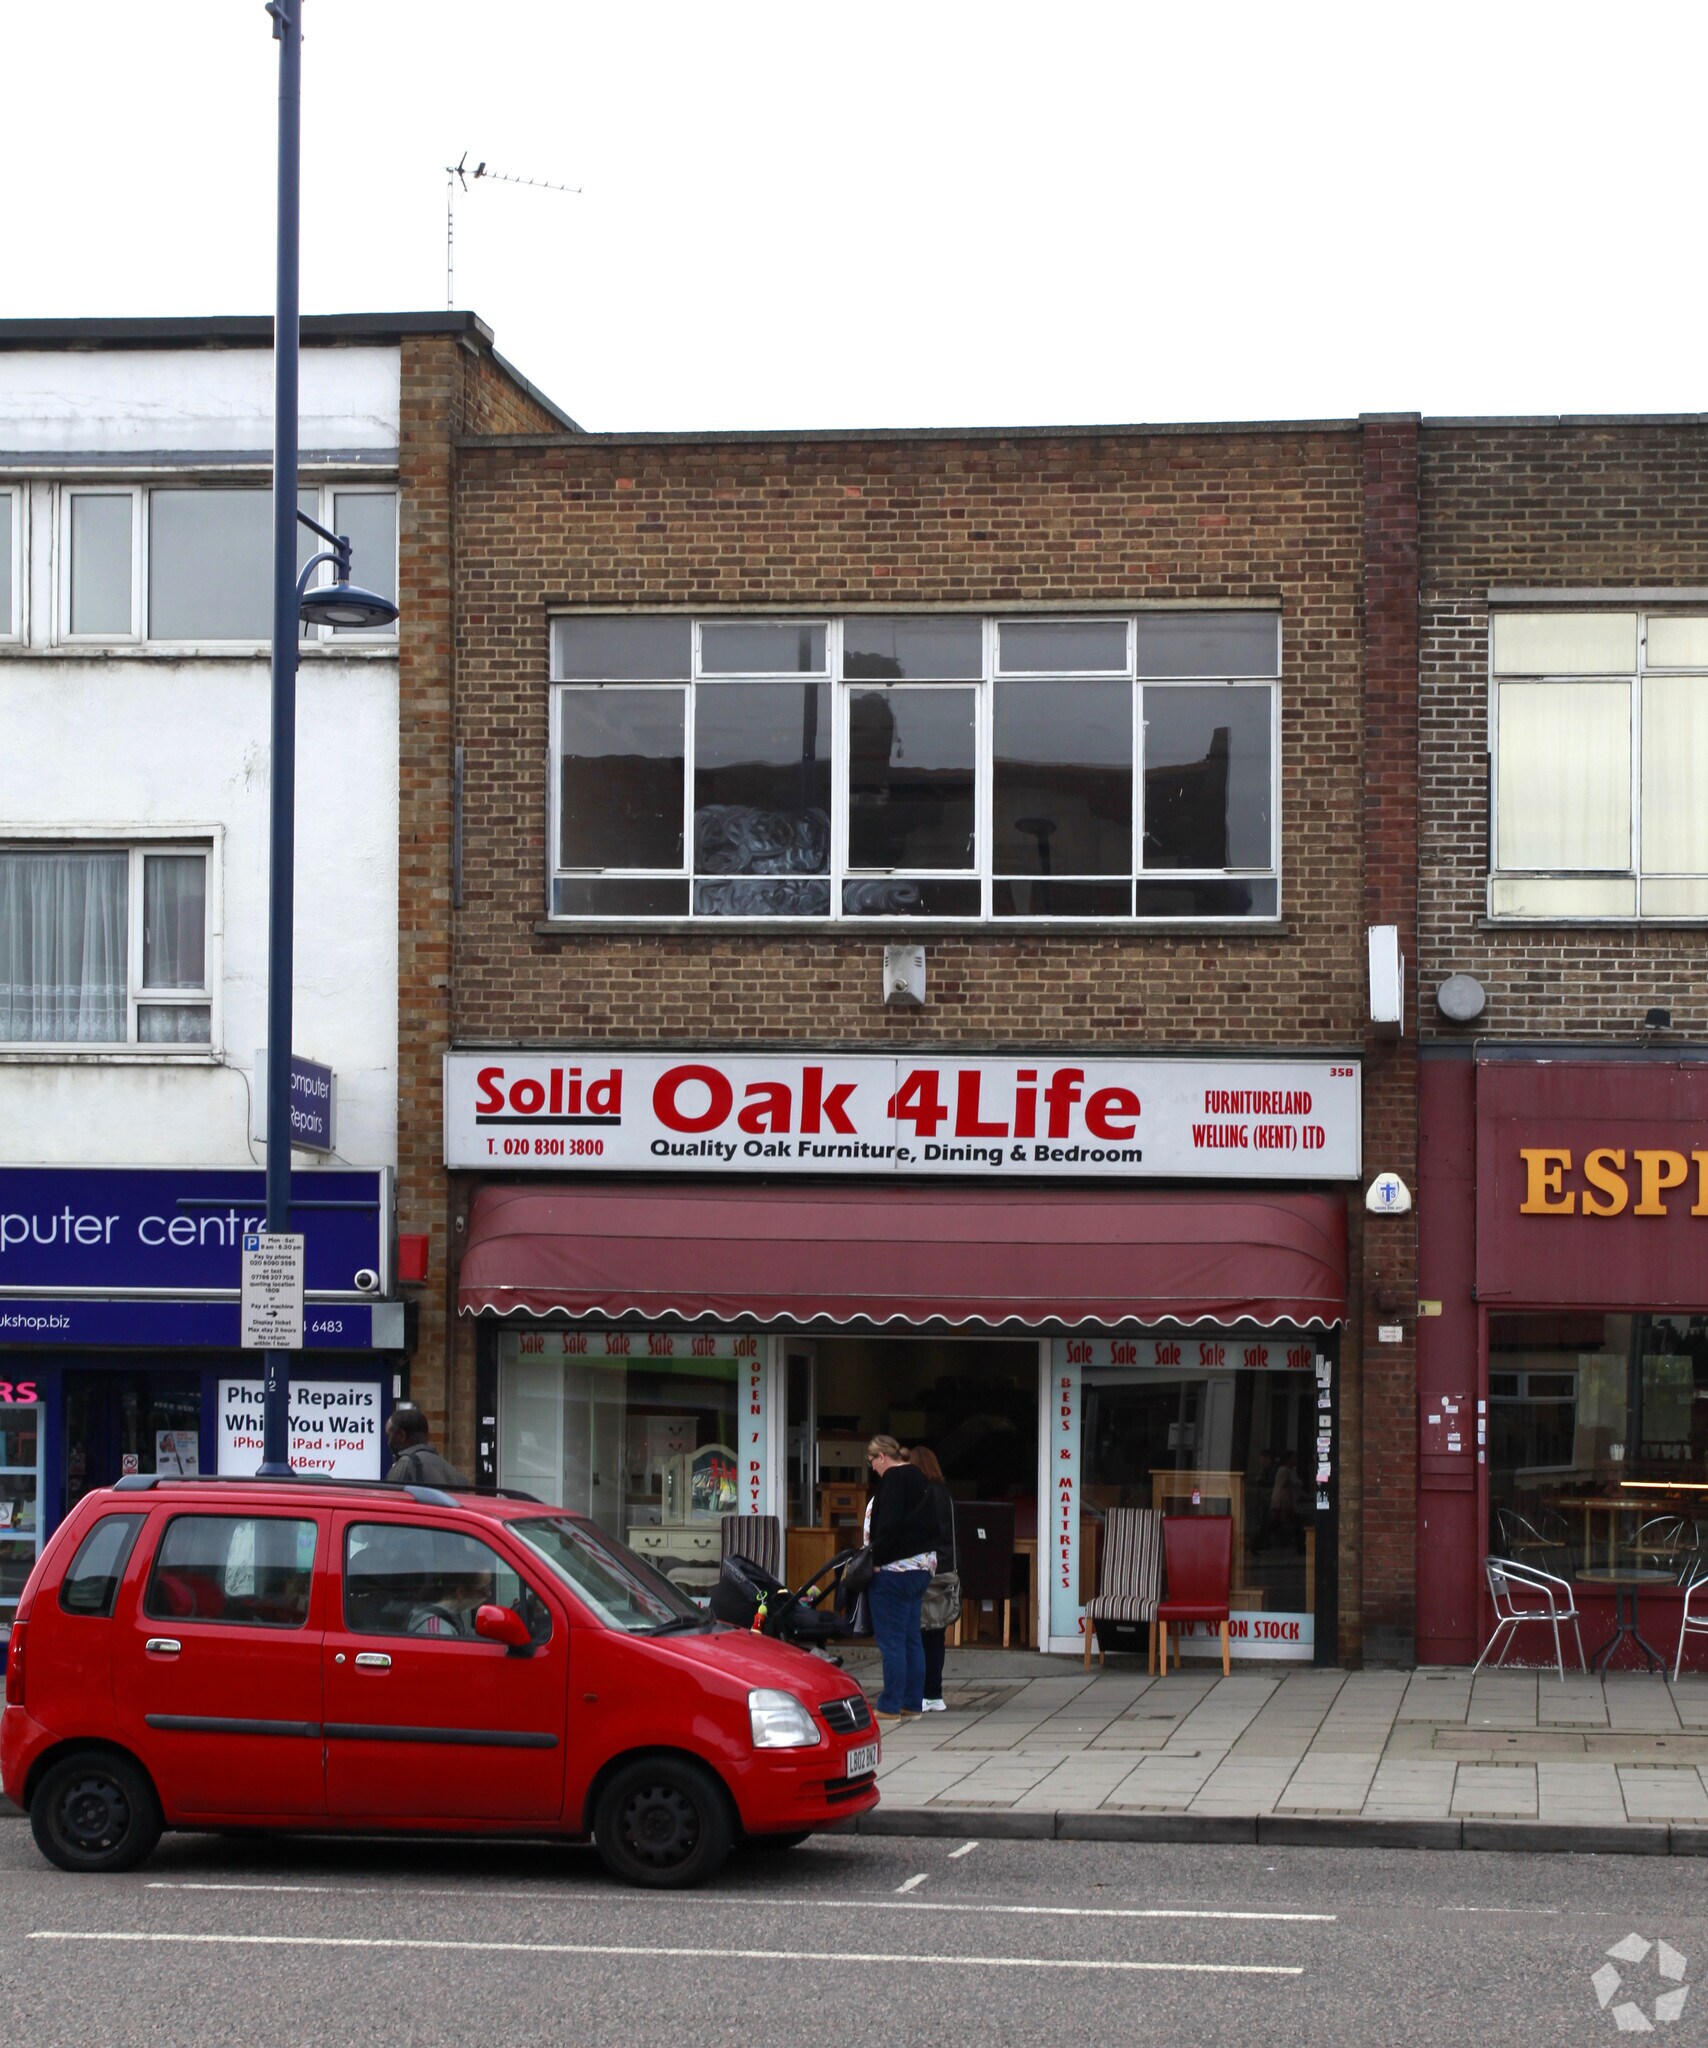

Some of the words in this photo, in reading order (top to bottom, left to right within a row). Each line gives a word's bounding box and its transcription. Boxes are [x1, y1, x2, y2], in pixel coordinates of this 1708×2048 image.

[1330, 1067, 1354, 1077] 35B
[291, 1073, 329, 1099] omputer
[475, 1067, 623, 1115] Solid
[652, 1064, 859, 1134] Oak
[887, 1068, 1141, 1140] 4Life
[1205, 1090, 1312, 1116] FURNITURELAND
[487, 1138, 498, 1155] T.
[503, 1138, 530, 1156] 020
[534, 1138, 565, 1156] 8301
[569, 1138, 604, 1156] 3800
[1192, 1124, 1249, 1149] WELLING
[1253, 1124, 1298, 1152] (KENT)
[1303, 1126, 1326, 1150] LTD
[650, 1139, 737, 1161] Quality
[742, 1140, 792, 1158] Oak
[798, 1141, 917, 1163] Furniture,
[924, 1144, 1004, 1166] Dining
[1010, 1144, 1028, 1162] &
[1034, 1145, 1142, 1163] Bedroom
[1520, 1148, 1708, 1217] ESP
[138, 1209, 267, 1246] centr
[247, 1237, 257, 1250] P
[311, 1320, 343, 1333] 6483
[1066, 1340, 1093, 1364] Sale
[1111, 1341, 1137, 1365] Sale
[1154, 1342, 1181, 1366] Sale
[1199, 1342, 1225, 1366] Sale
[297, 1388, 373, 1410] Repairs
[750, 1362, 761, 1415] OPEN
[1060, 1377, 1071, 1431] BEDS
[288, 1416, 324, 1433] You
[329, 1417, 375, 1434] Wait
[292, 1438, 322, 1450] iPad
[334, 1438, 364, 1451] iPod
[1060, 1449, 1071, 1460] &
[750, 1461, 760, 1514] DAYS
[1059, 1477, 1073, 1588] MATTRESS
[1228, 1619, 1248, 1638] ON
[1254, 1621, 1300, 1640] STOCK
